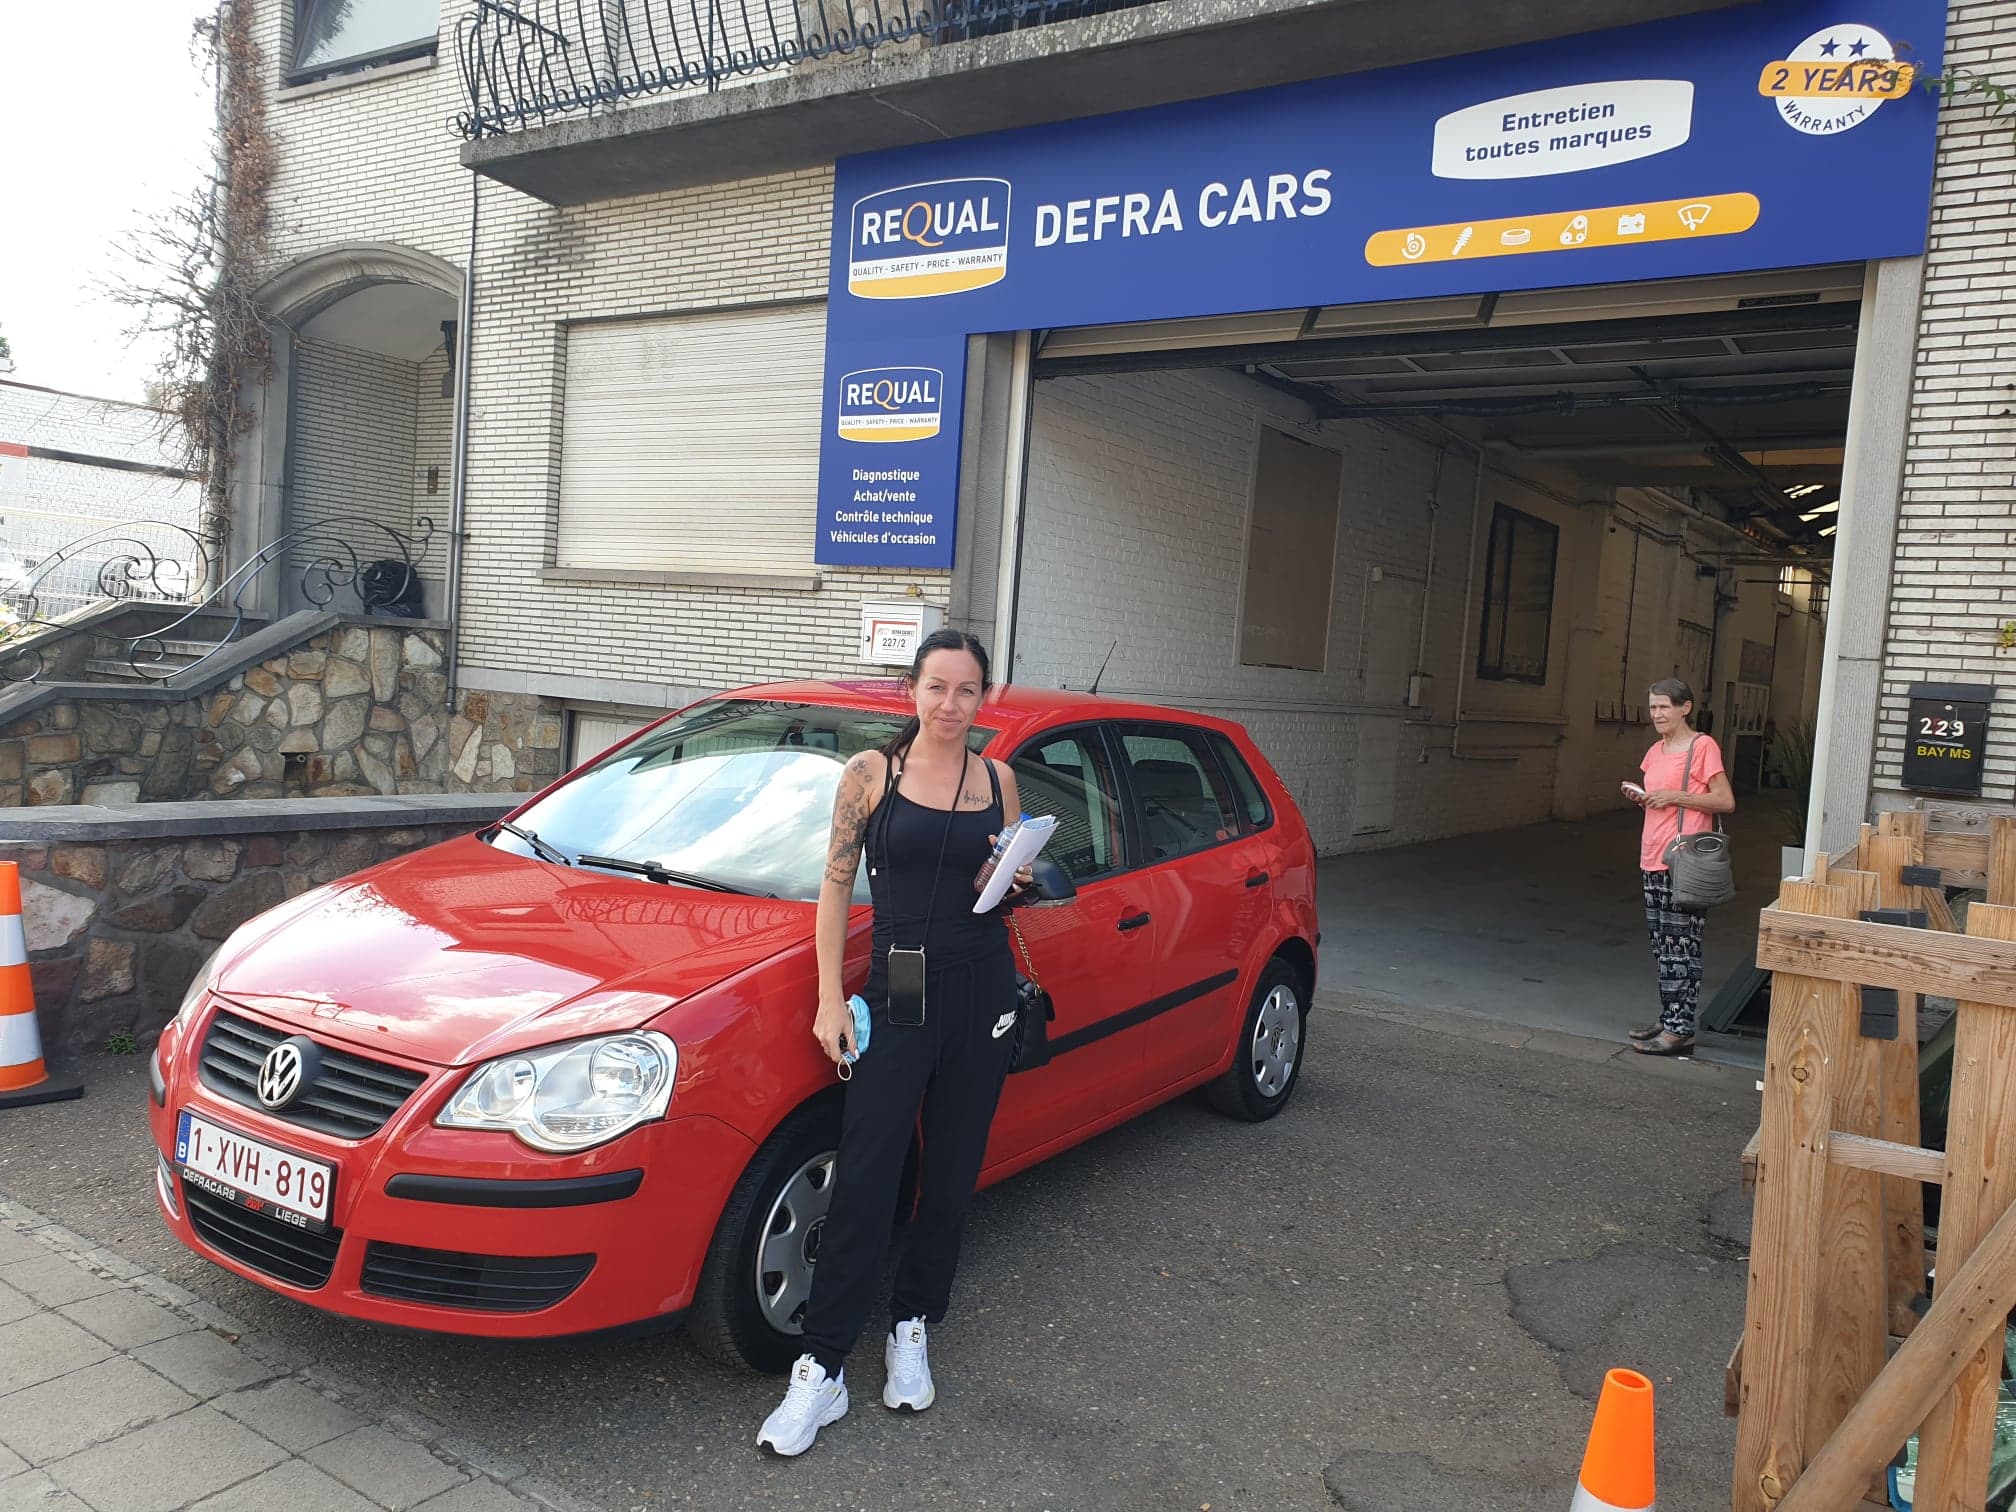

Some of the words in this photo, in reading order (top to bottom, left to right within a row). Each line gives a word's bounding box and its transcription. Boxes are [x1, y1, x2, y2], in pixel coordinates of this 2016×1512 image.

[1771, 68, 1789, 91] 2
[1804, 68, 1900, 92] YEARS
[1501, 100, 1615, 132] Entretien
[1784, 100, 1866, 131] WARRANTY
[1465, 138, 1540, 162] toutes
[1549, 121, 1652, 152] marques
[1034, 188, 1184, 248] DEFRA
[1198, 168, 1333, 229] CARS
[861, 196, 1000, 248] REQUAL
[852, 265, 884, 277] QUALITY
[890, 262, 919, 273] SAFETY
[927, 259, 950, 269] PRICE
[958, 253, 1003, 266] WARRANTY
[846, 379, 936, 410] REQUAL
[852, 468, 920, 483] Diagnostique
[853, 488, 916, 503] Achat/vente
[835, 510, 879, 523] Contrôle
[881, 511, 933, 526] technique
[830, 530, 879, 543] Véhicules
[881, 532, 936, 545] d'occasion
[882, 637, 906, 649] 227/2
[1920, 717, 1964, 738] 229
[1917, 746, 1946, 758] BAY
[1949, 748, 1972, 760] MS
[177, 1141, 187, 1158] B
[194, 1127, 325, 1209] 1-XVH-819
[183, 1168, 236, 1201] DEFRACARS
[275, 1207, 308, 1228] LIEGE
